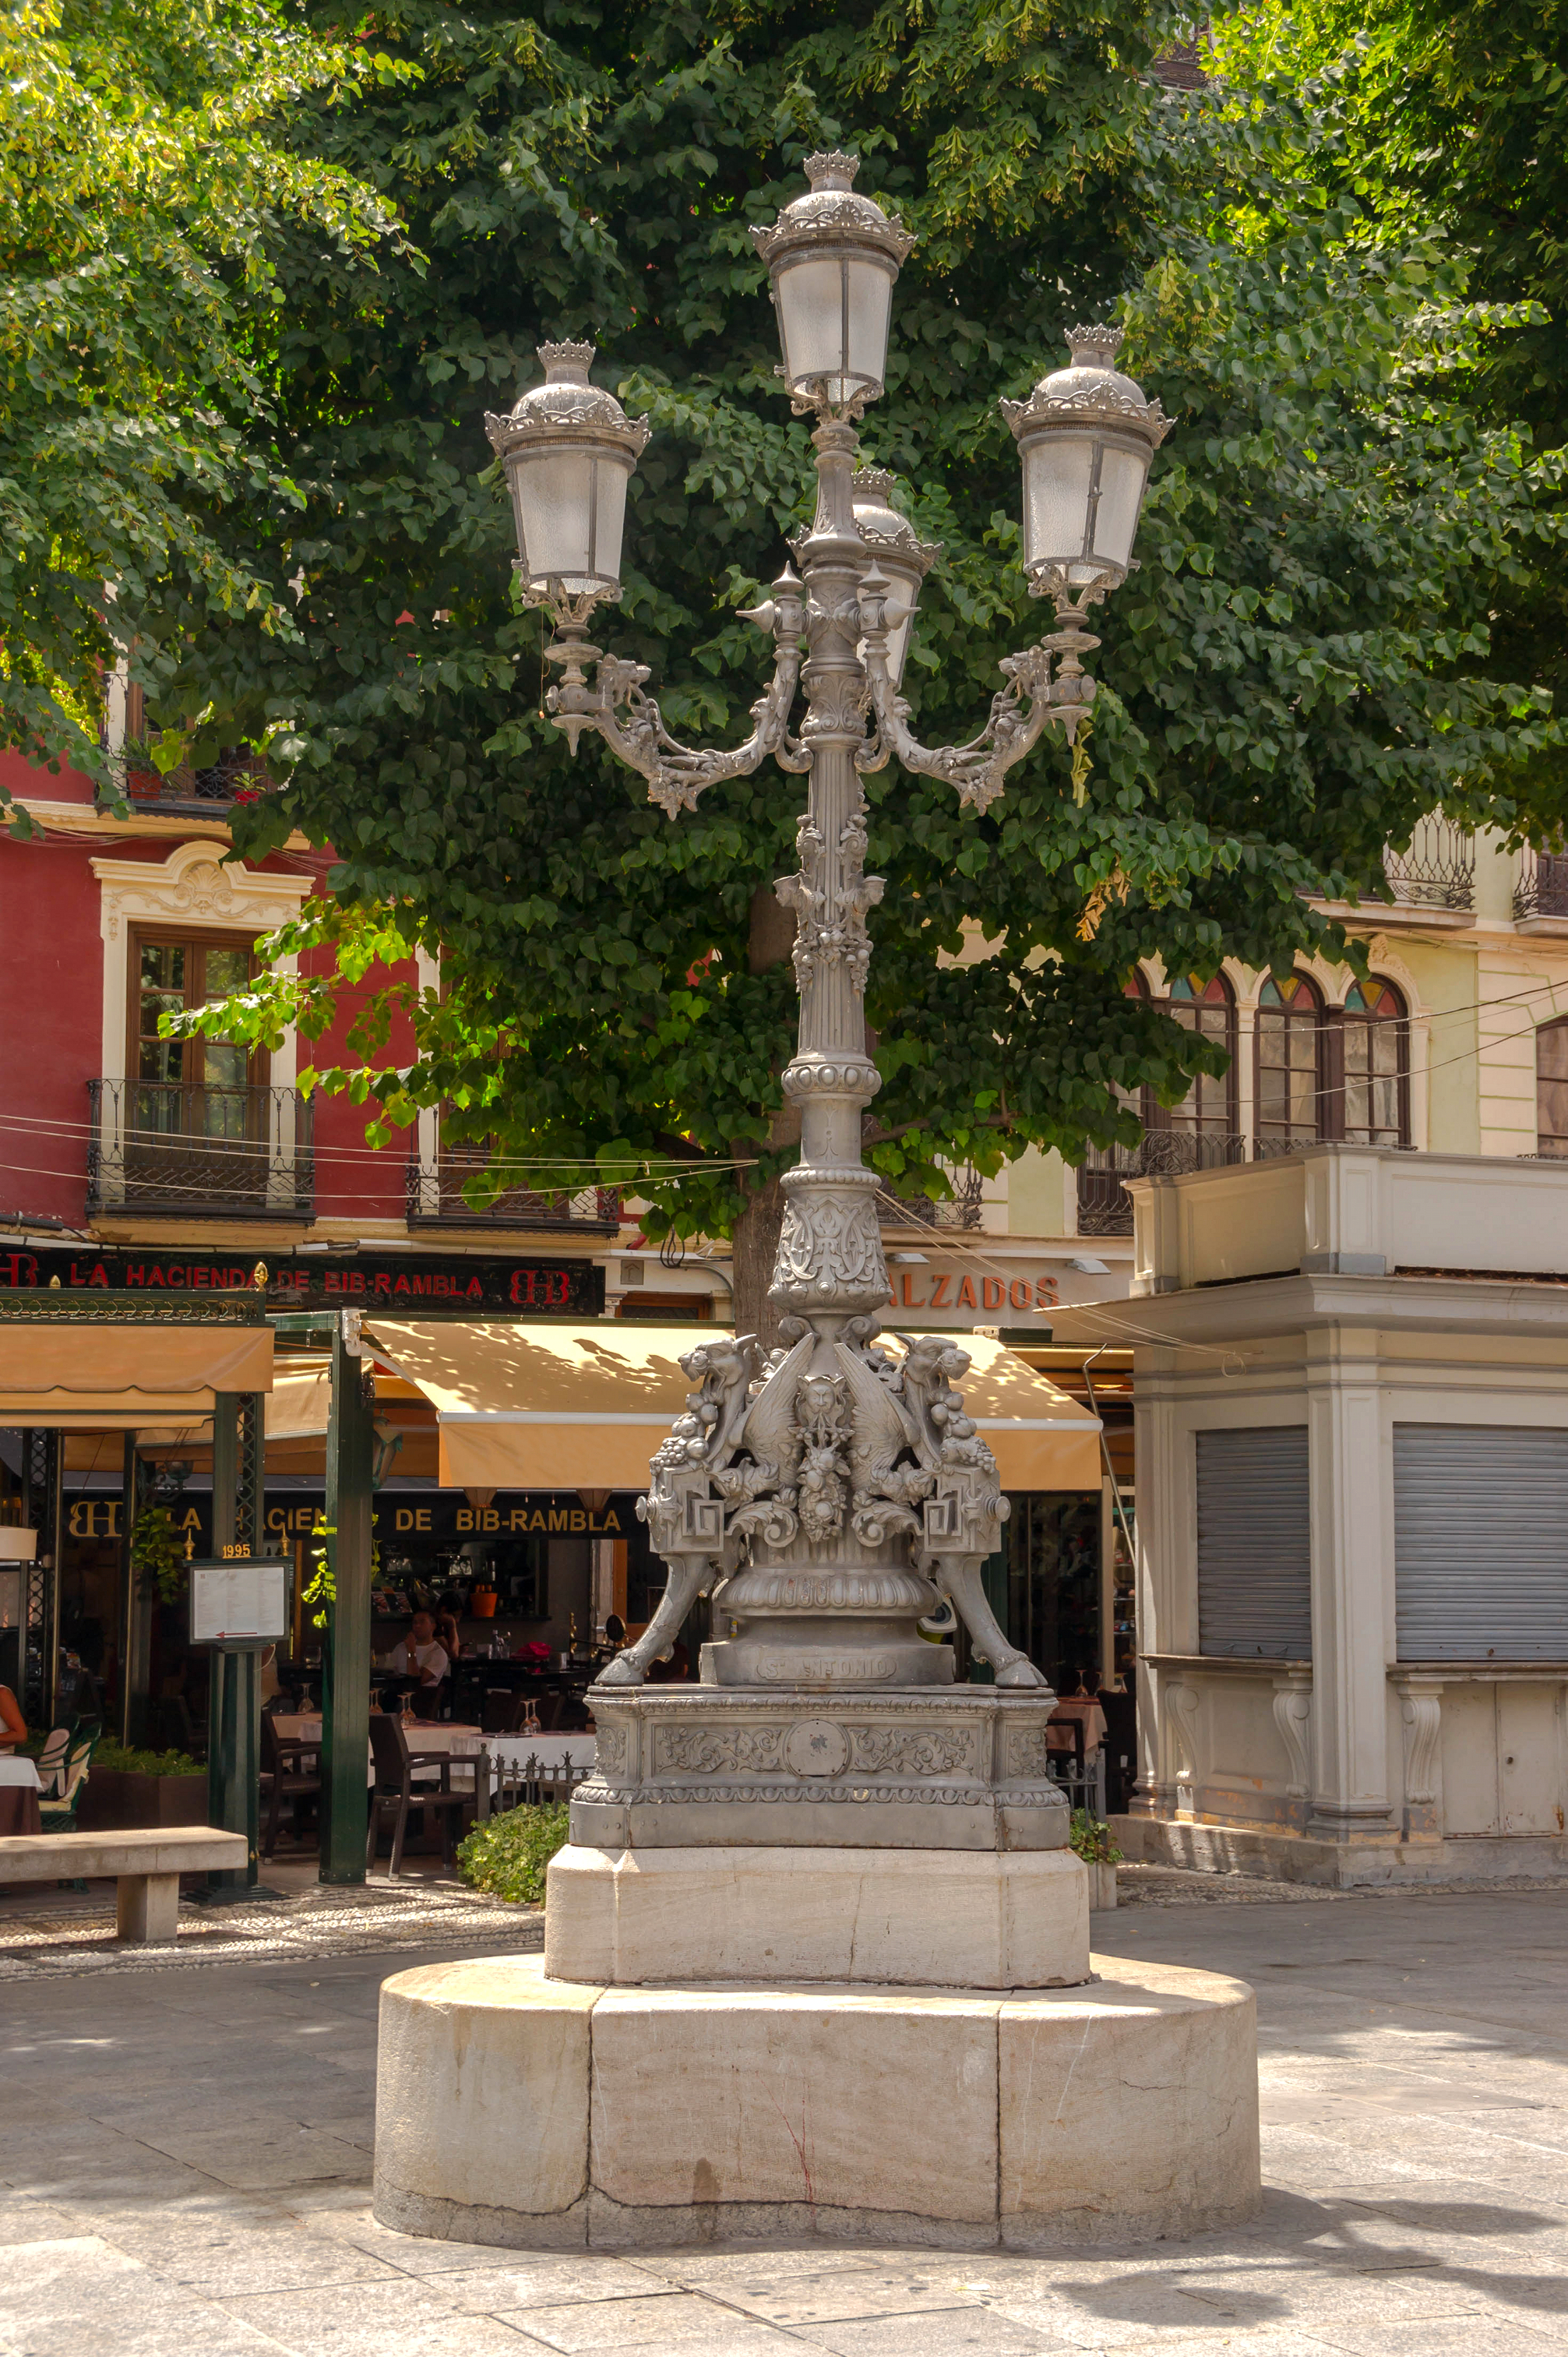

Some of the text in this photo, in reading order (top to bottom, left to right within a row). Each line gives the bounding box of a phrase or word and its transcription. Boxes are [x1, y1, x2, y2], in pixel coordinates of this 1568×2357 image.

[70, 1263, 109, 1288] LA
[277, 1270, 310, 1291] DE
[324, 1272, 484, 1297] BIB-RAMBLA
[396, 1508, 432, 1531] DE
[456, 1509, 622, 1531] BIB-RAMBLA
[223, 1544, 250, 1557] 1995
